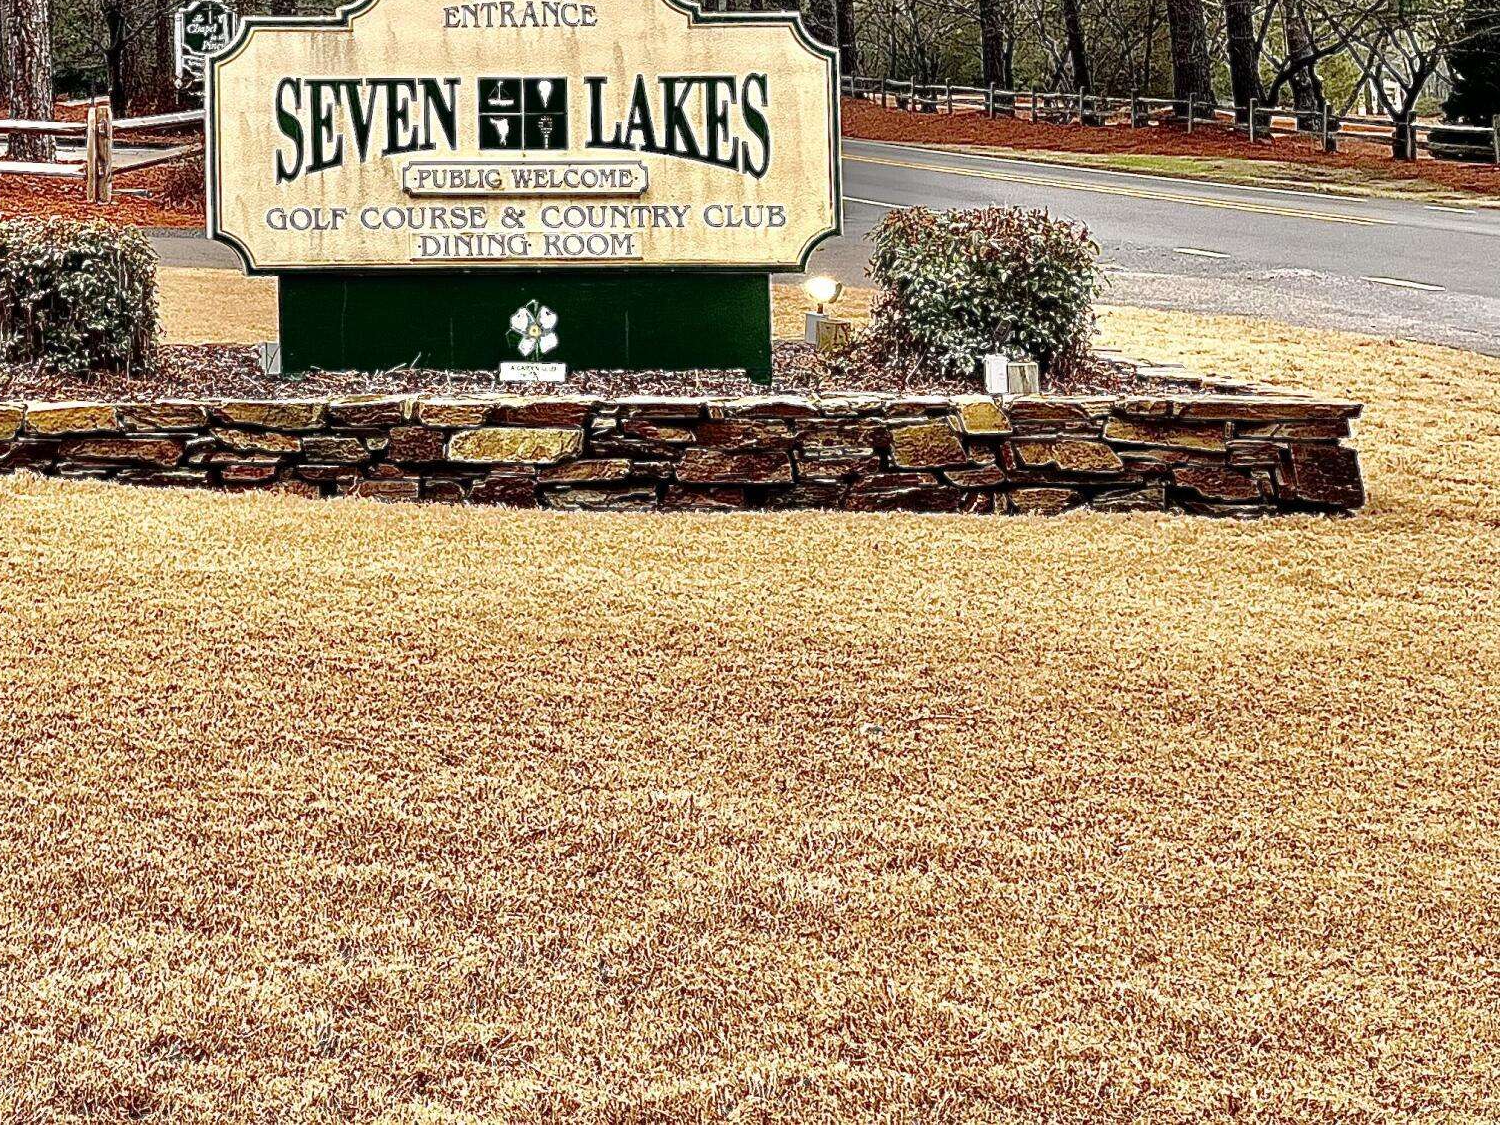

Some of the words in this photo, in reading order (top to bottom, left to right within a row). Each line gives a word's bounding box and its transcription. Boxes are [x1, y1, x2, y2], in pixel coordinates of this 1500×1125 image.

[443, 1, 598, 28] ENTRANCE
[275, 76, 461, 185] SEVEN
[583, 73, 771, 178] LAKES
[511, 169, 633, 188] WELCOME
[266, 207, 348, 230] GOLF
[360, 206, 488, 229] COURSE
[501, 206, 526, 229] &
[541, 205, 691, 228] COUNTRY
[703, 204, 786, 228] CLUB
[420, 233, 529, 257] DINING
[543, 234, 633, 256] ROOM
